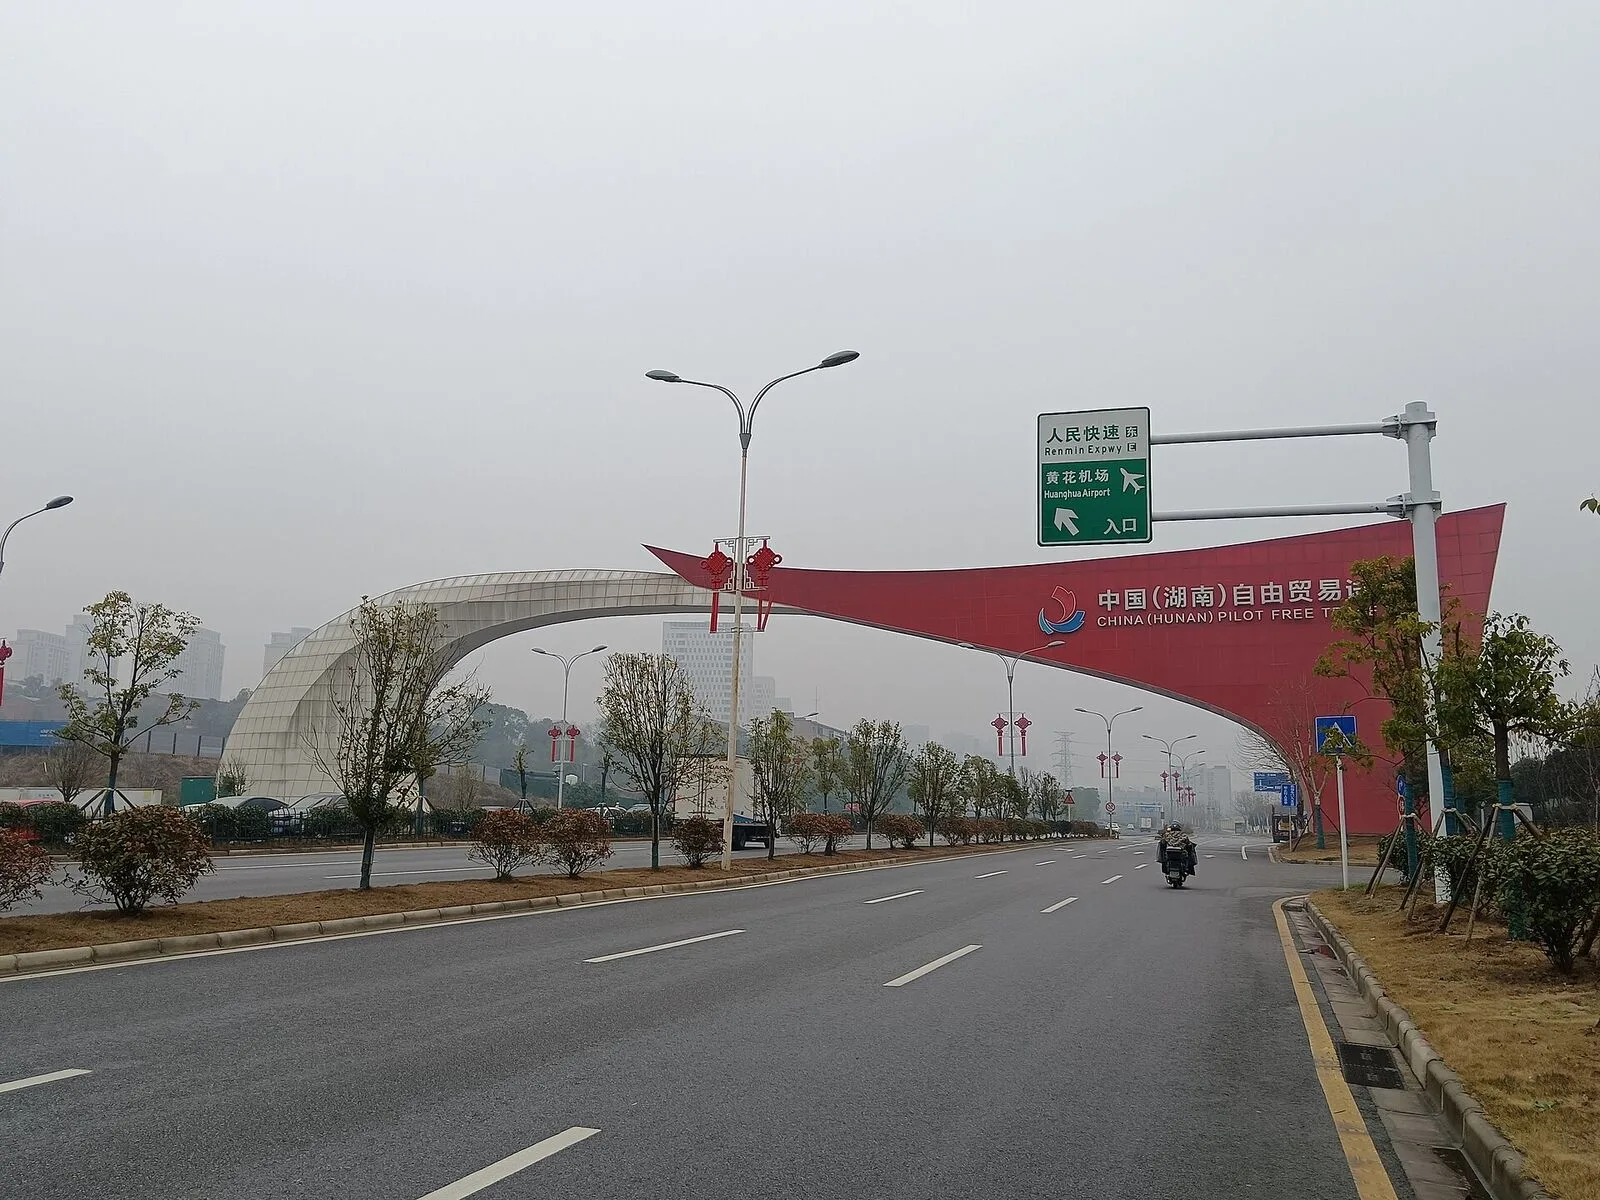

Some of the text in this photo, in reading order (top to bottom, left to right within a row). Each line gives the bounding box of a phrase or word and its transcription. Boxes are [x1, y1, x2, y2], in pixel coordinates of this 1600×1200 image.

[1046, 424, 1120, 444] 人民快速
[1044, 445, 1085, 456] Renmin
[1088, 444, 1122, 455] Expwy
[1045, 469, 1109, 485] 黄花机场
[1044, 487, 1111, 500] Huanghua Airport
[1103, 518, 1137, 535] 入口
[1097, 614, 1144, 627] CHINA
[1147, 610, 1213, 626] (HUNAN)
[1218, 610, 1264, 622] PILOT
[1271, 607, 1314, 620] FREE
